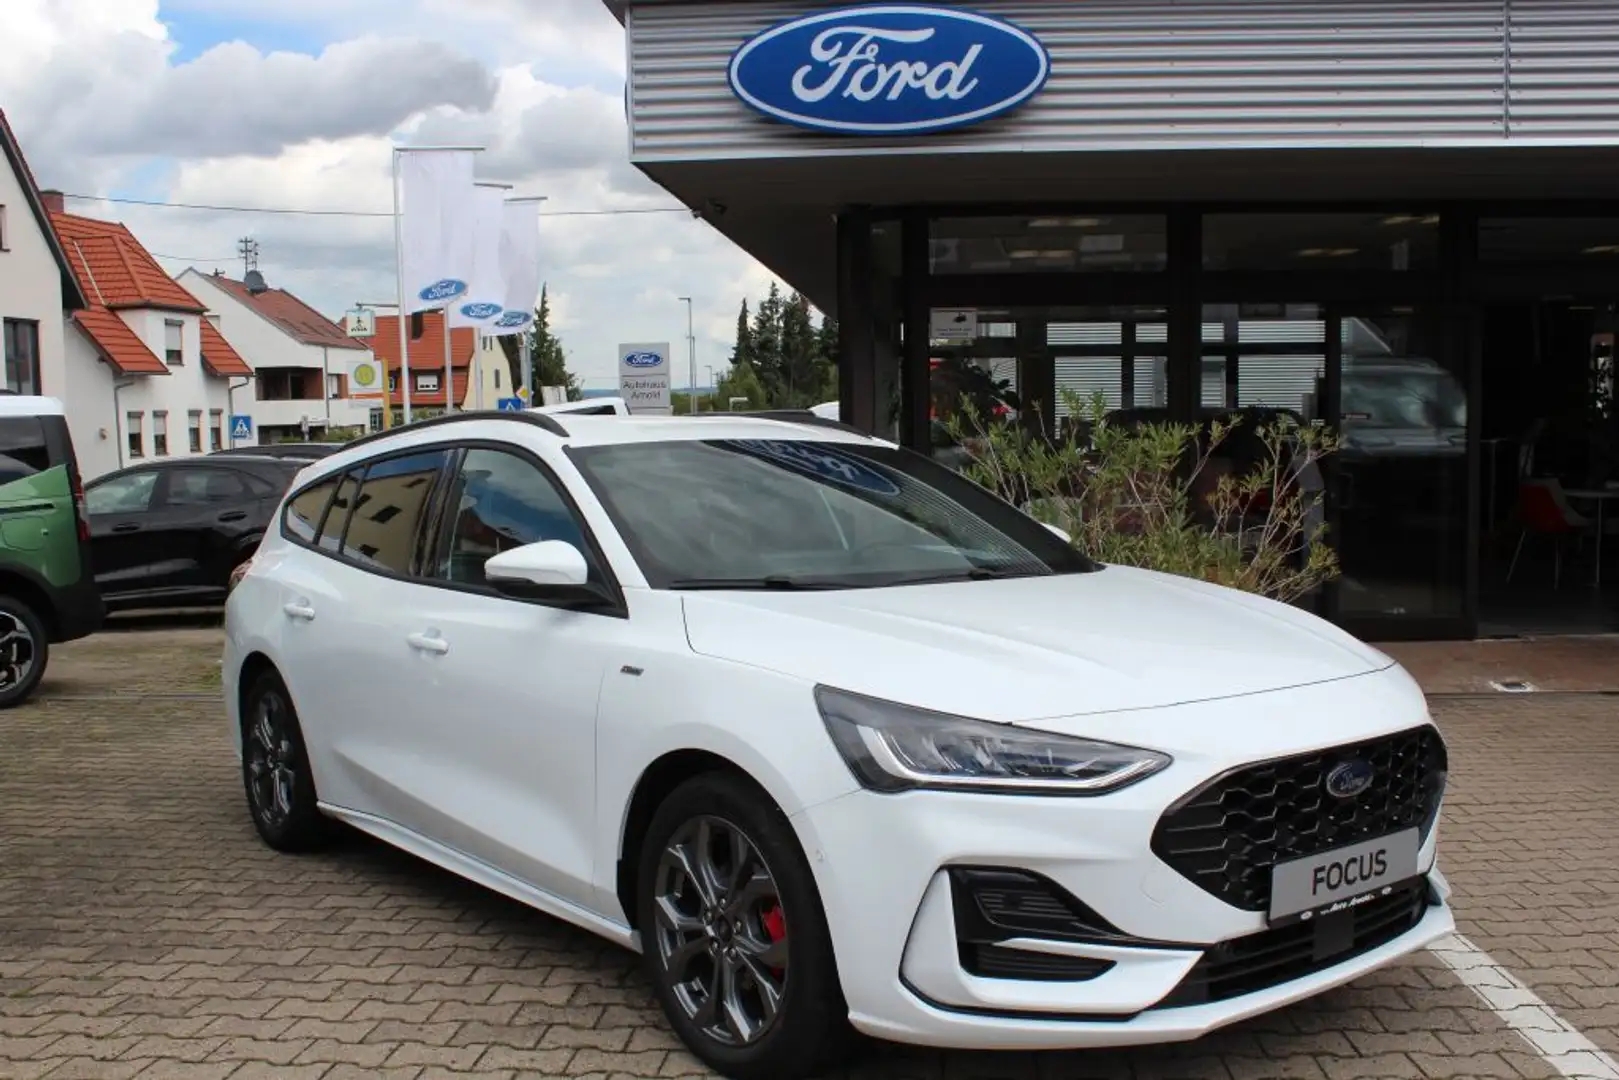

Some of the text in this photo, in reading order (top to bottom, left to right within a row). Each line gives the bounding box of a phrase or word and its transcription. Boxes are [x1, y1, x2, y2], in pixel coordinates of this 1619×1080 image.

[791, 25, 983, 103] Ford
[428, 281, 457, 299] Ford
[469, 304, 494, 317] Ford
[622, 380, 667, 390] Autohaus
[1311, 848, 1388, 896] FOCUS
